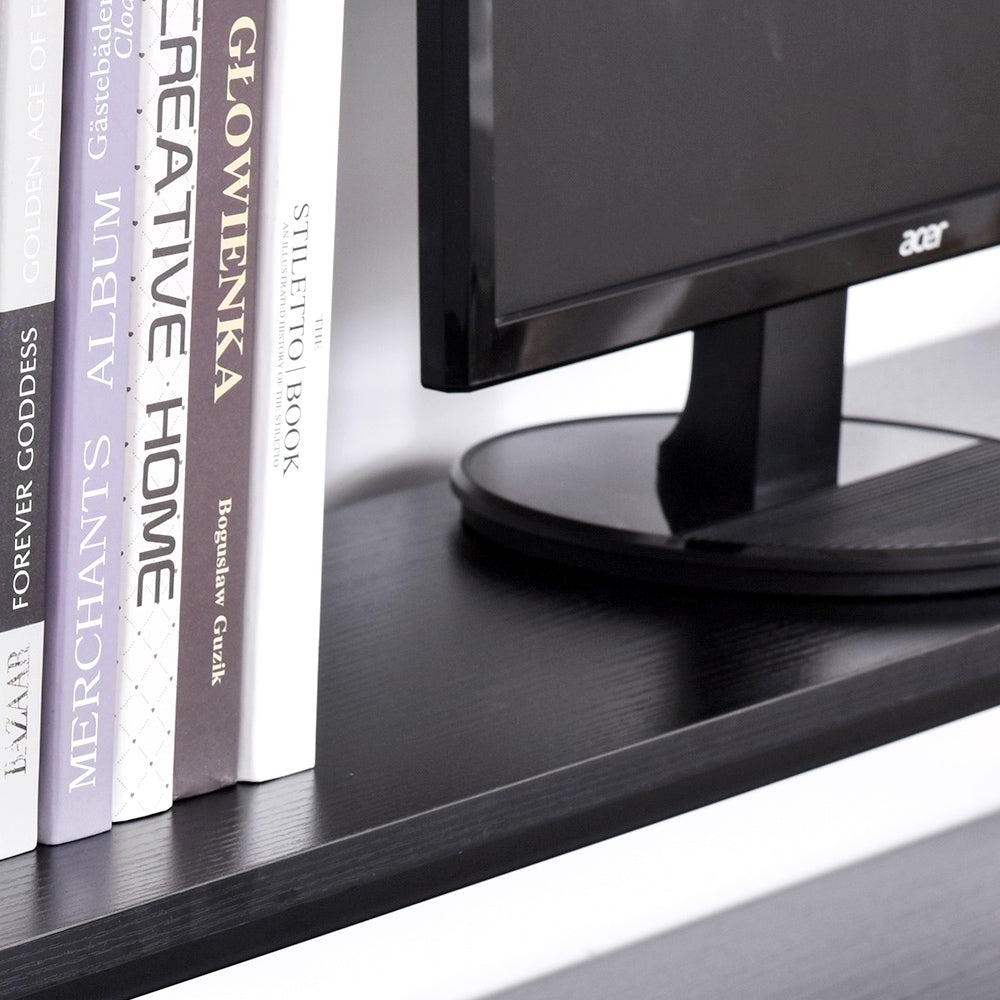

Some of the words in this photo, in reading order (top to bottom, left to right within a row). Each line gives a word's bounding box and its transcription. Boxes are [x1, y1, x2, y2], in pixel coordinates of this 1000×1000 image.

[27, 81, 46, 143] AGE
[29, 31, 47, 72] OF
[22, 156, 43, 284] GOLDEN
[213, 15, 258, 404] GŁOWIENKA
[898, 220, 950, 257] acer
[86, 186, 122, 390] ALBUM
[288, 203, 310, 362] STILETTO
[16, 326, 39, 472] GODDESS
[282, 380, 303, 479] BOOK
[11, 479, 34, 611] FOREVER
[137, 397, 183, 607] HOME
[213, 496, 233, 607] Boguslaw
[68, 433, 112, 794] MERCHANTS
[211, 614, 228, 687] Guzik
